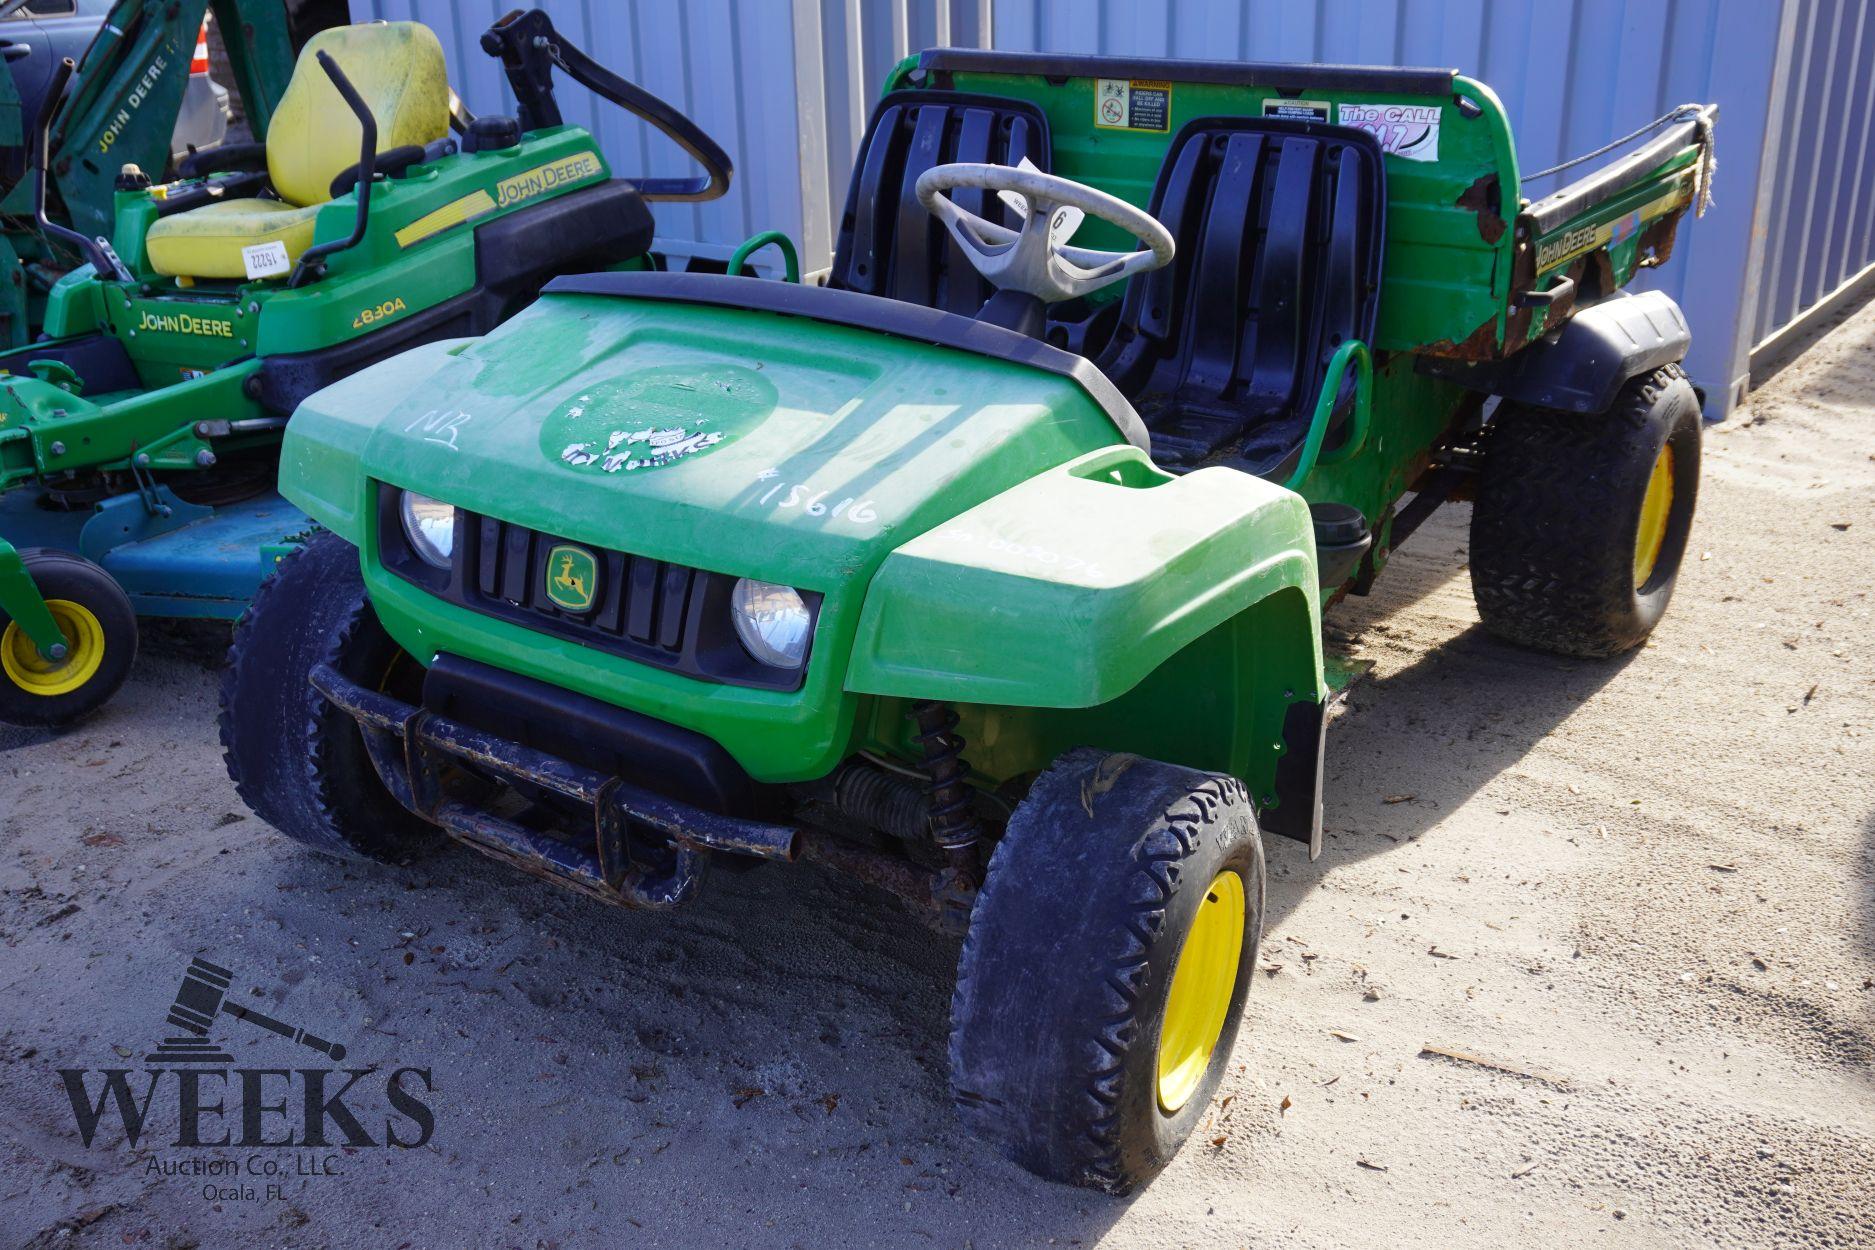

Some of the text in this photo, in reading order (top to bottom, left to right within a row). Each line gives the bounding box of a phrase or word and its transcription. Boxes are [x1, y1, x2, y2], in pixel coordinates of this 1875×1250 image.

[99, 55, 168, 153] JOHN DEERE
[1341, 106, 1380, 122] The
[1384, 107, 1441, 124] CALL
[498, 158, 593, 204] JOHN DEERE
[251, 251, 277, 269] 15222
[1535, 223, 1597, 269] JOHN DEERE
[139, 310, 233, 337] JOHN DEERE
